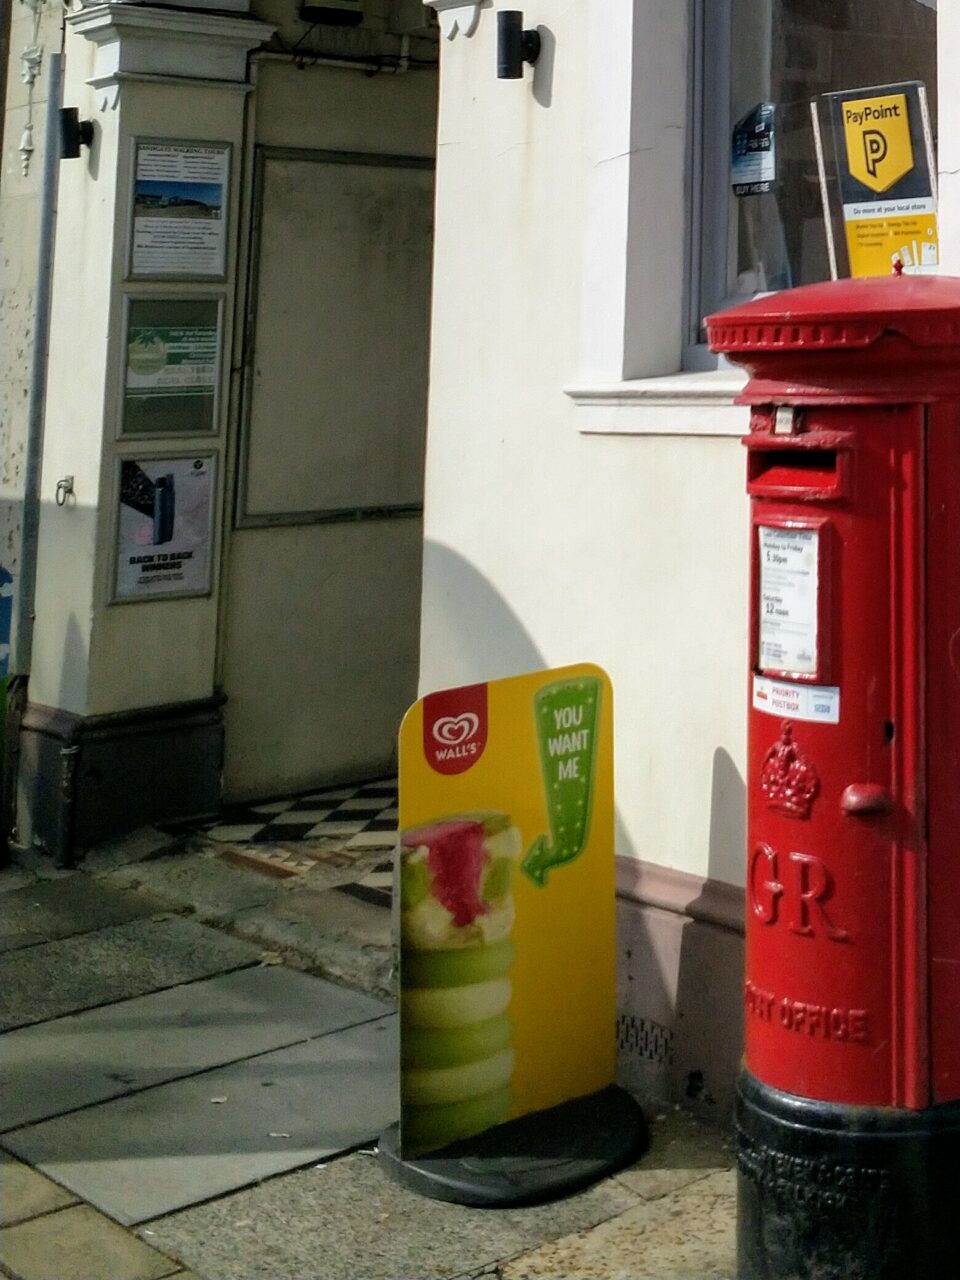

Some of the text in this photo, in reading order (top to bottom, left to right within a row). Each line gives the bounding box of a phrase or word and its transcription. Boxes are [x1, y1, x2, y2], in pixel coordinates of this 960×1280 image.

[845, 104, 901, 126] PayPoint
[553, 705, 583, 730] YOU
[435, 742, 478, 762] WALL'S
[548, 730, 590, 757] WANT
[557, 757, 581, 782] ME
[751, 841, 856, 945] GR
[780, 996, 869, 1041] OFFICE
